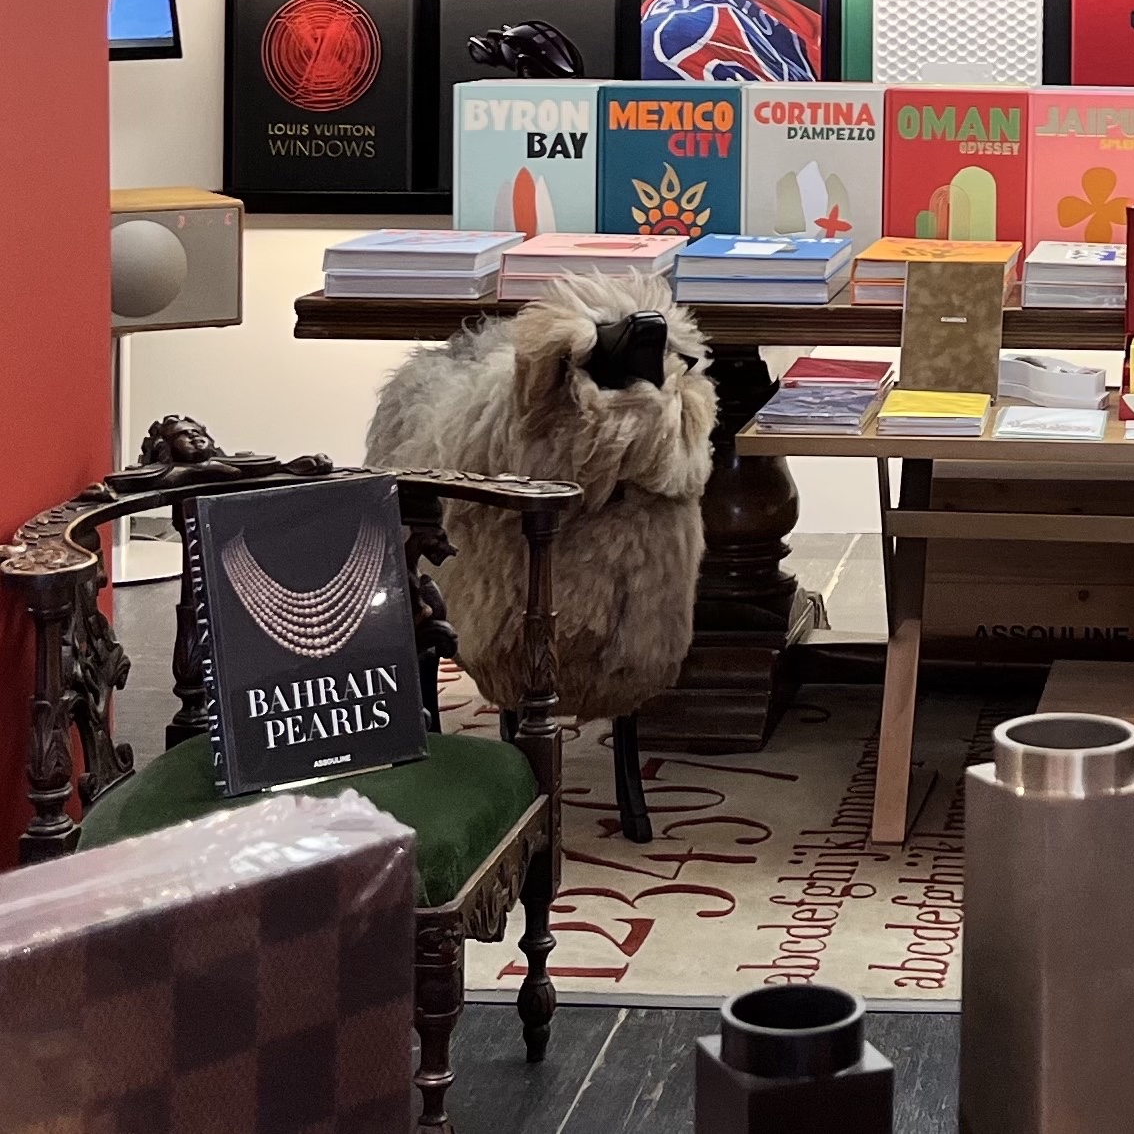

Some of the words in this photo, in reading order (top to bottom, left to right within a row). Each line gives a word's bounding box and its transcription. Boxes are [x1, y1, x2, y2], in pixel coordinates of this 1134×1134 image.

[464, 99, 590, 131] BYRON
[609, 100, 734, 131] MEXICO
[754, 101, 876, 126] CORTINA
[897, 105, 1021, 142] OMAN
[268, 123, 309, 136] LOUIS
[313, 123, 376, 137] VUITTON
[787, 126, 876, 141] D'AMPEZZO
[268, 139, 376, 157] WINDOWS
[526, 132, 588, 159] BAY
[668, 132, 732, 157] CITY
[959, 141, 1021, 155] ODYSSEY
[246, 664, 399, 719] BAHRAIN
[264, 700, 391, 750] PEARLS
[313, 753, 352, 768] ASSOULINE
